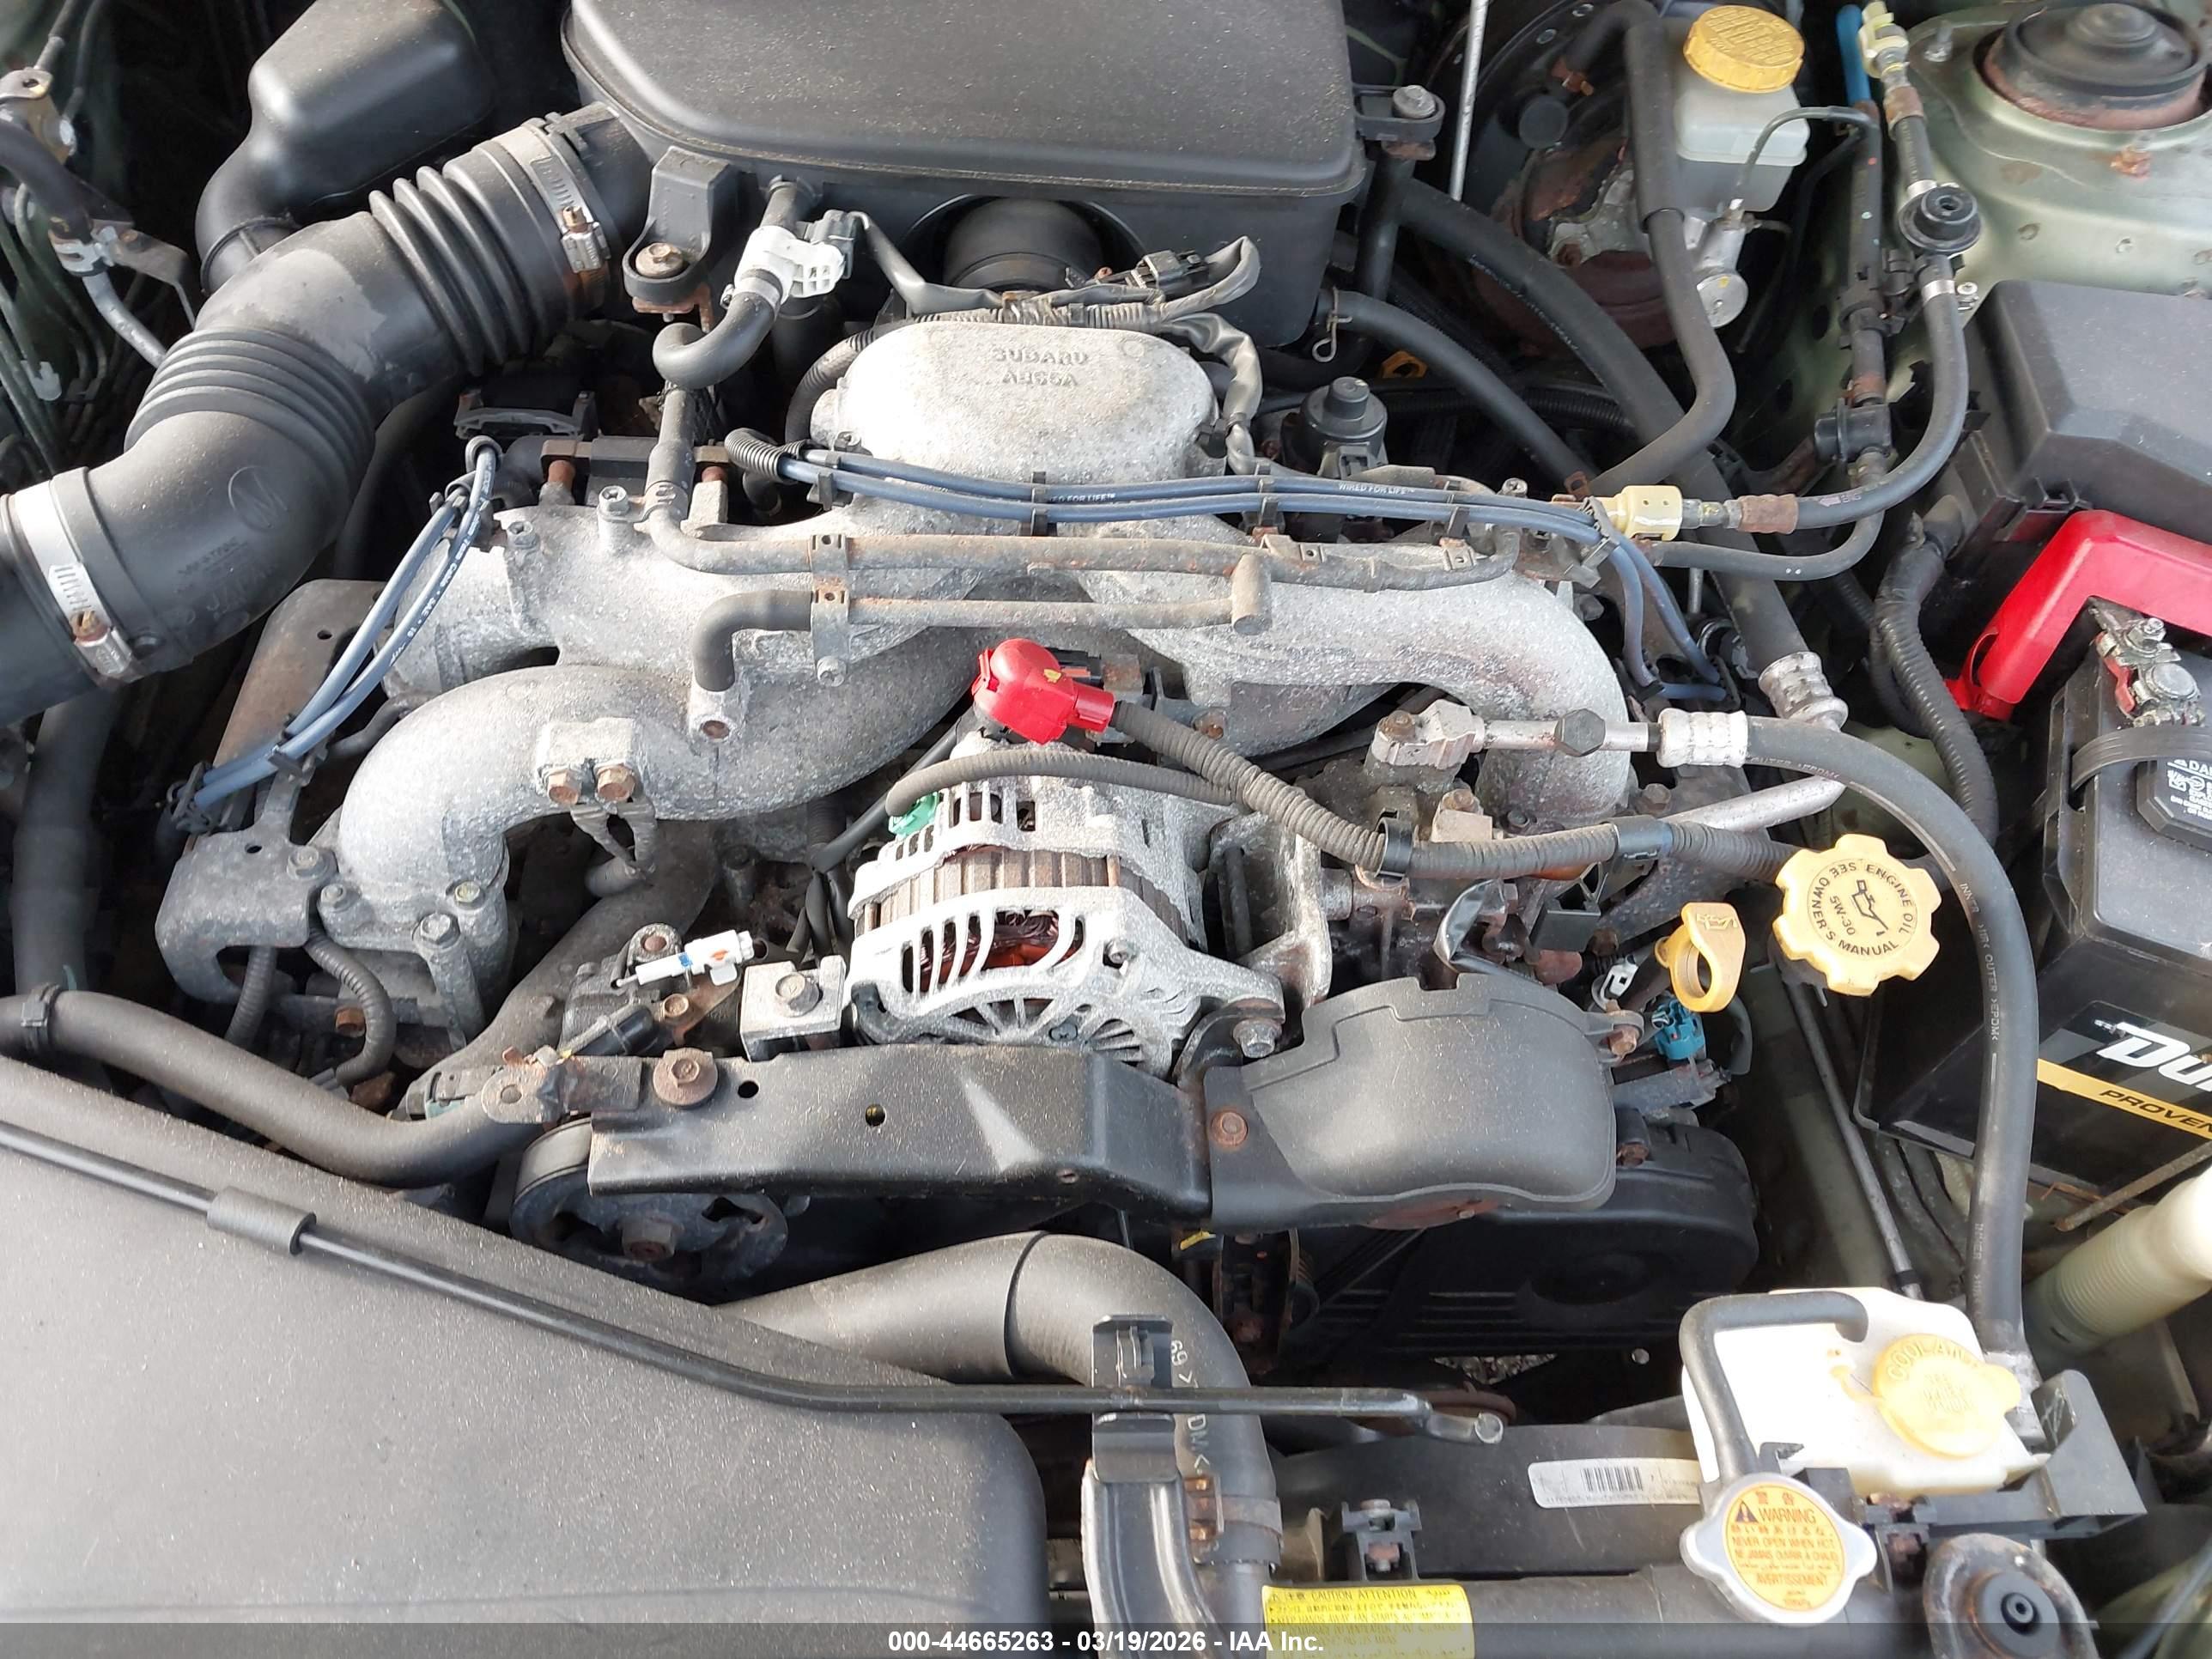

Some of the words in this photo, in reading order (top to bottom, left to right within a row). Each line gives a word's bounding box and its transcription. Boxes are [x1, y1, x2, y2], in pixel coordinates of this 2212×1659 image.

[991, 345, 1089, 366] SUBARU
[1368, 485, 1388, 494] FOR
[1066, 495, 1086, 503] FOR
[2188, 759, 2212, 777] DA
[1828, 861, 1857, 878] SEE
[1811, 876, 1836, 941] OWNER'S
[1865, 864, 1914, 908] ENGINE
[1898, 913, 1914, 935] OIL
[1829, 895, 1856, 936] 5W-30
[1837, 939, 1899, 957] MANUAL
[1984, 952, 1999, 994] OUTER
[2095, 1021, 2212, 1092] Du
[1758, 1507, 1817, 1525] WARNING
[1762, 1537, 1786, 1547] OPEN
[1788, 1538, 1814, 1548] WHEN
[1311, 1589, 1354, 1601] CAUTION
[1358, 1589, 1417, 1601] ATTENTION
